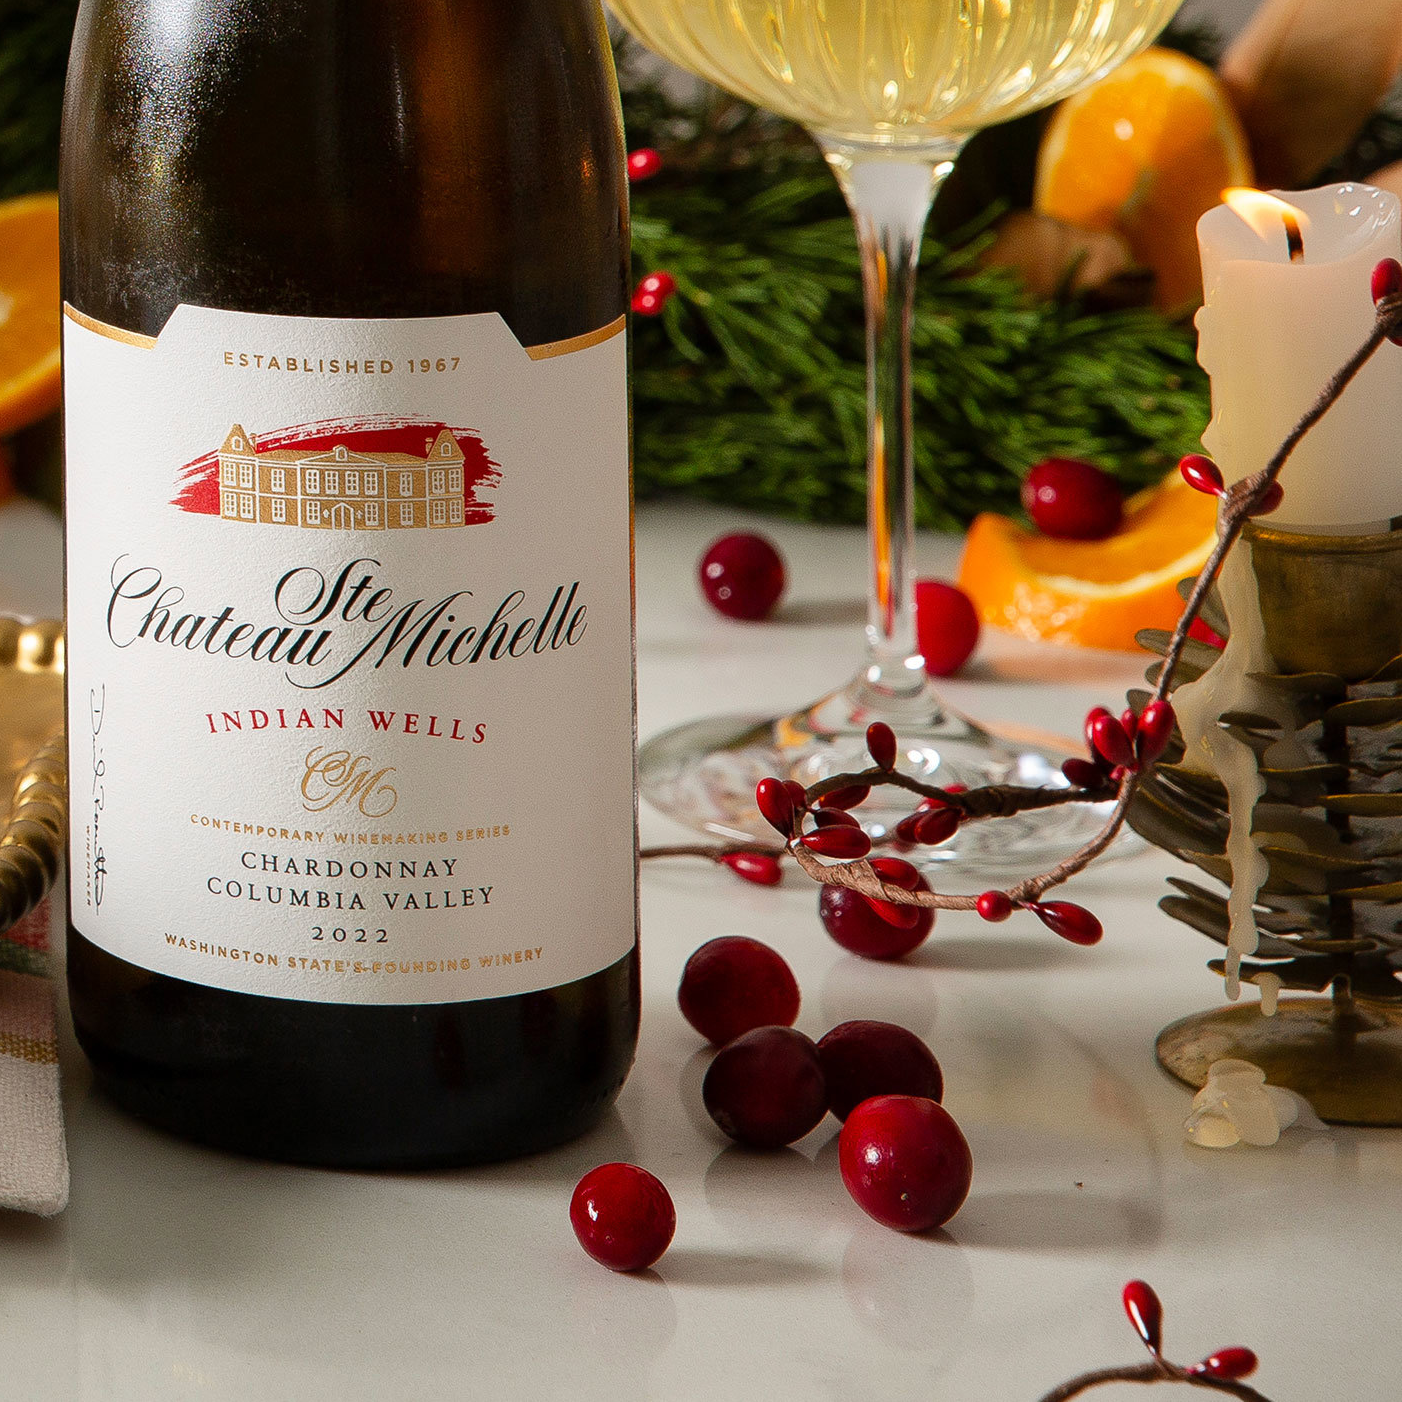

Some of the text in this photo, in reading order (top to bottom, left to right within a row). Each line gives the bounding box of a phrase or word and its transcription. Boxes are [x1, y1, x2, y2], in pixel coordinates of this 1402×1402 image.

[223, 350, 462, 375] ESTABLISHED 1967
[107, 553, 589, 690] Chateau Ste Michelle
[205, 707, 489, 745] INDIAN WELLS
[189, 813, 512, 845] CONTEMPORARY WINEMAKING SERIES
[85, 825, 93, 907] WINEMAKER
[241, 851, 459, 879] CHARDONNAY
[206, 876, 495, 911] COLUMBIA VALLEY
[310, 925, 390, 944] 2022
[163, 932, 544, 974] WASHINGTON STATE'S FOUNDING WINERY
